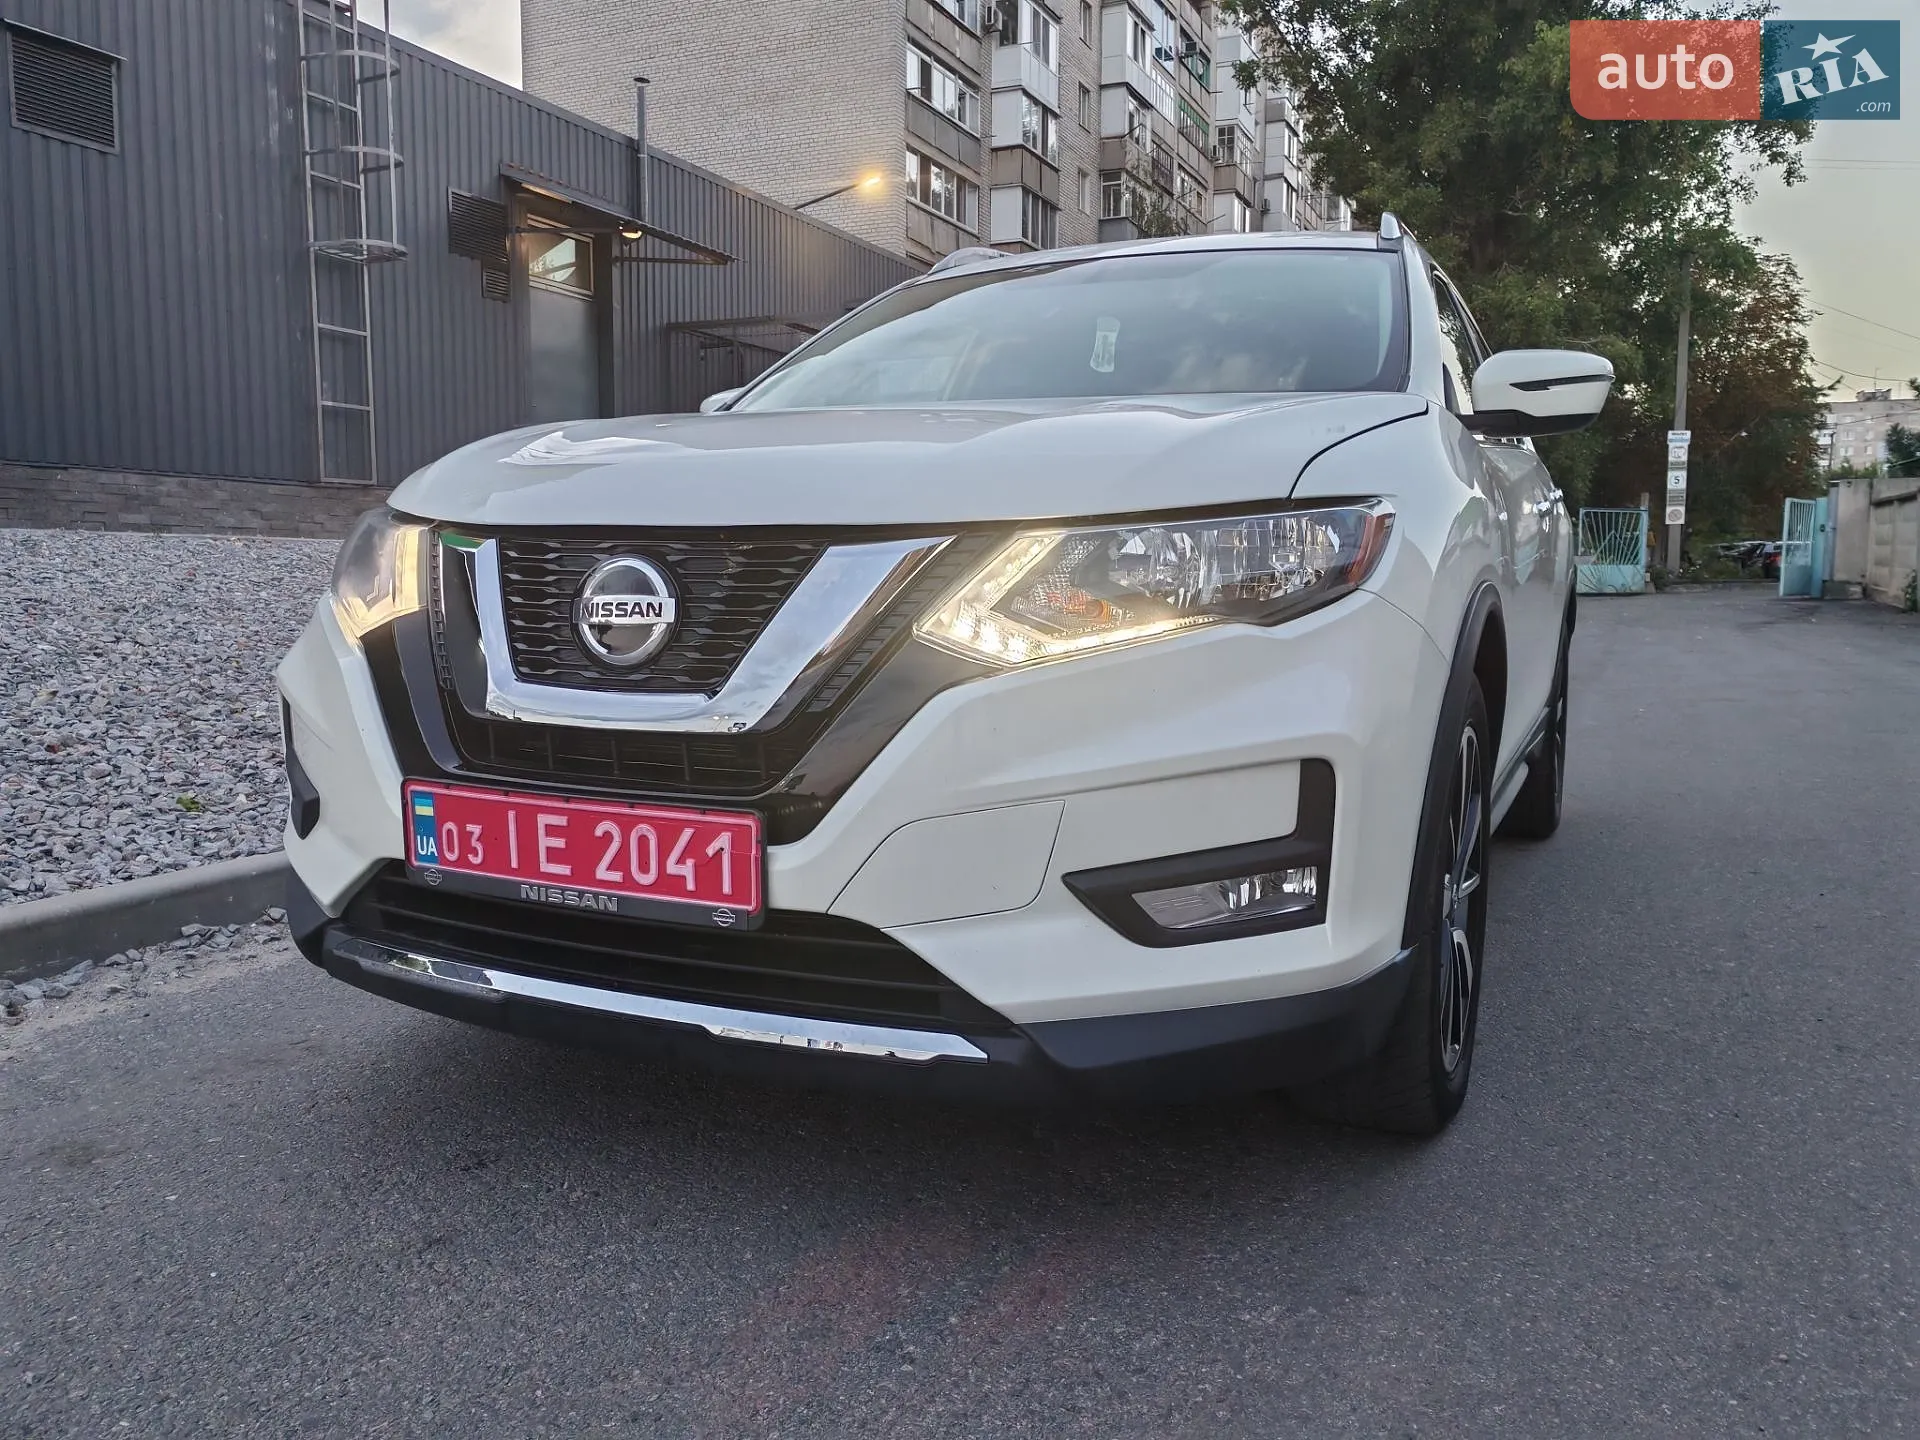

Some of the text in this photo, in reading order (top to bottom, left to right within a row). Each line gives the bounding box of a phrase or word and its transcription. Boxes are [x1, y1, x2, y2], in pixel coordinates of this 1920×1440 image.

[582, 601, 663, 619] NISSAN
[417, 835, 438, 856] UA
[442, 810, 732, 895] 03 IE 2041
[519, 884, 618, 912] NISSAN
